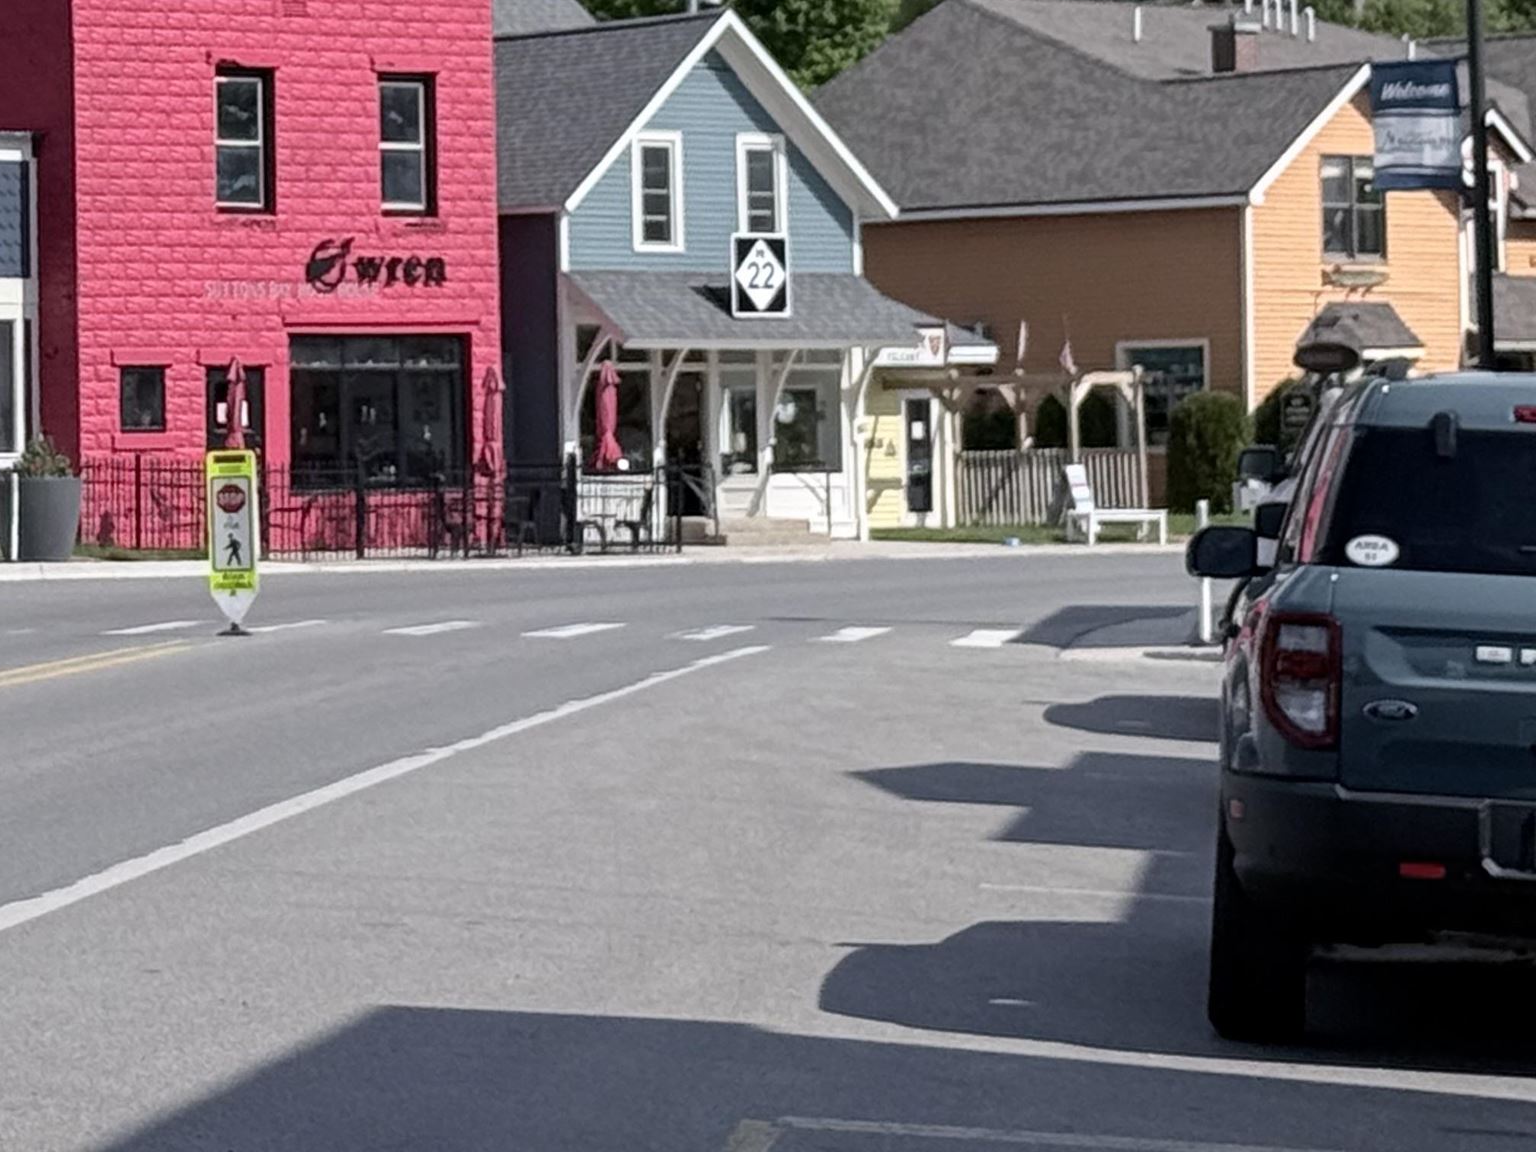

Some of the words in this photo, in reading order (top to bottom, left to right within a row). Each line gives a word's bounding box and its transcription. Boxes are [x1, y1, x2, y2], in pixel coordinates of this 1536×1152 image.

[1380, 81, 1450, 101] Welcome
[352, 256, 447, 288] wren
[747, 261, 775, 289] 22
